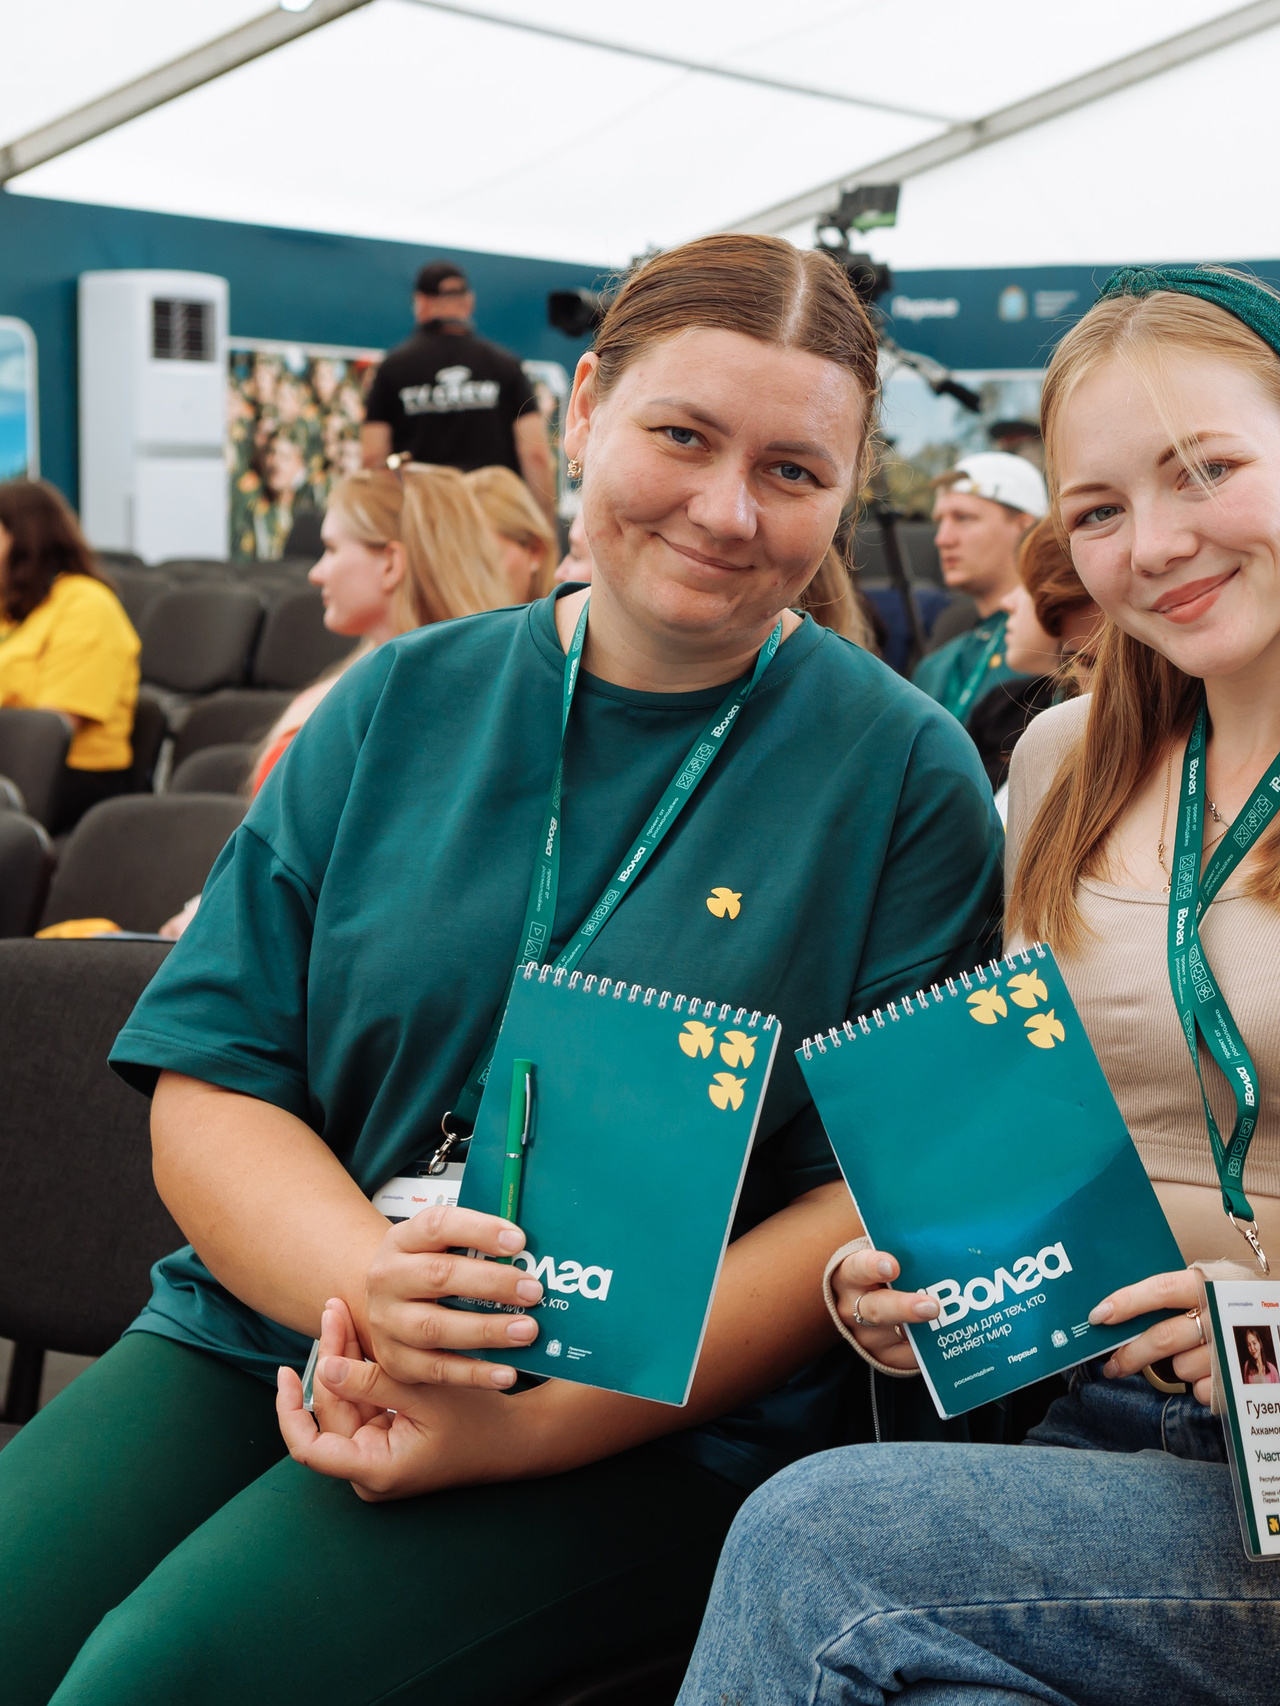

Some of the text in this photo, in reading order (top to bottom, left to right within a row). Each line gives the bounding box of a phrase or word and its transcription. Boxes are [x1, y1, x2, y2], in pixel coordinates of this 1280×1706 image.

[549, 1297, 570, 1311] кто
[937, 1292, 1047, 1349] форум для тех, кто
[942, 1323, 1012, 1361] меняет мир
[1007, 1346, 1038, 1364] Первые
